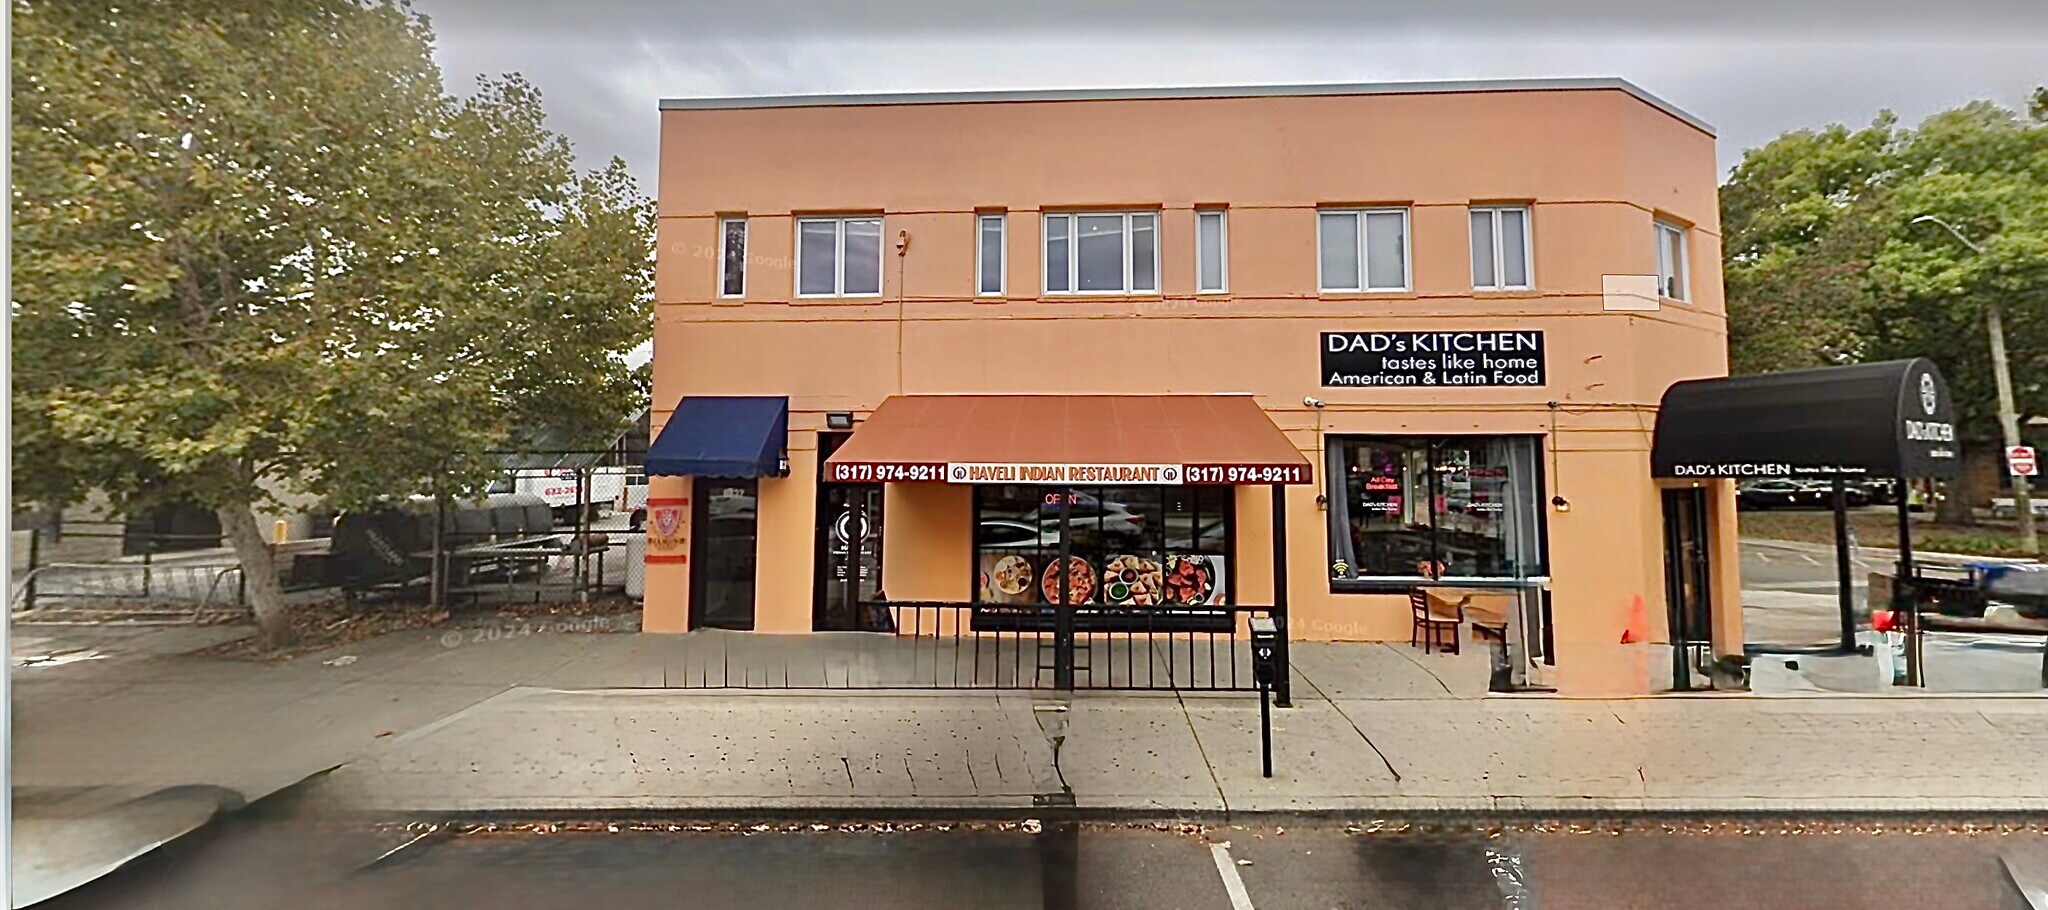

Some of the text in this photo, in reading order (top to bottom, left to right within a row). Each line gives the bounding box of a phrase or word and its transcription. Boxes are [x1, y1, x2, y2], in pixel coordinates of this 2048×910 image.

[1328, 333, 1537, 352] DAD's KITCHEN
[1381, 353, 1538, 370] tastes like home
[1329, 370, 1539, 385] American & Latin Food
[835, 464, 946, 481] (317) 974-9211
[969, 465, 1161, 482] HAVELI INDIAN RESTAURANT
[1185, 466, 1300, 482] (317) 974-9211
[1674, 464, 1716, 476] DAD's
[1717, 463, 1791, 475] KITCHEN
[1045, 493, 1077, 505] OPN
